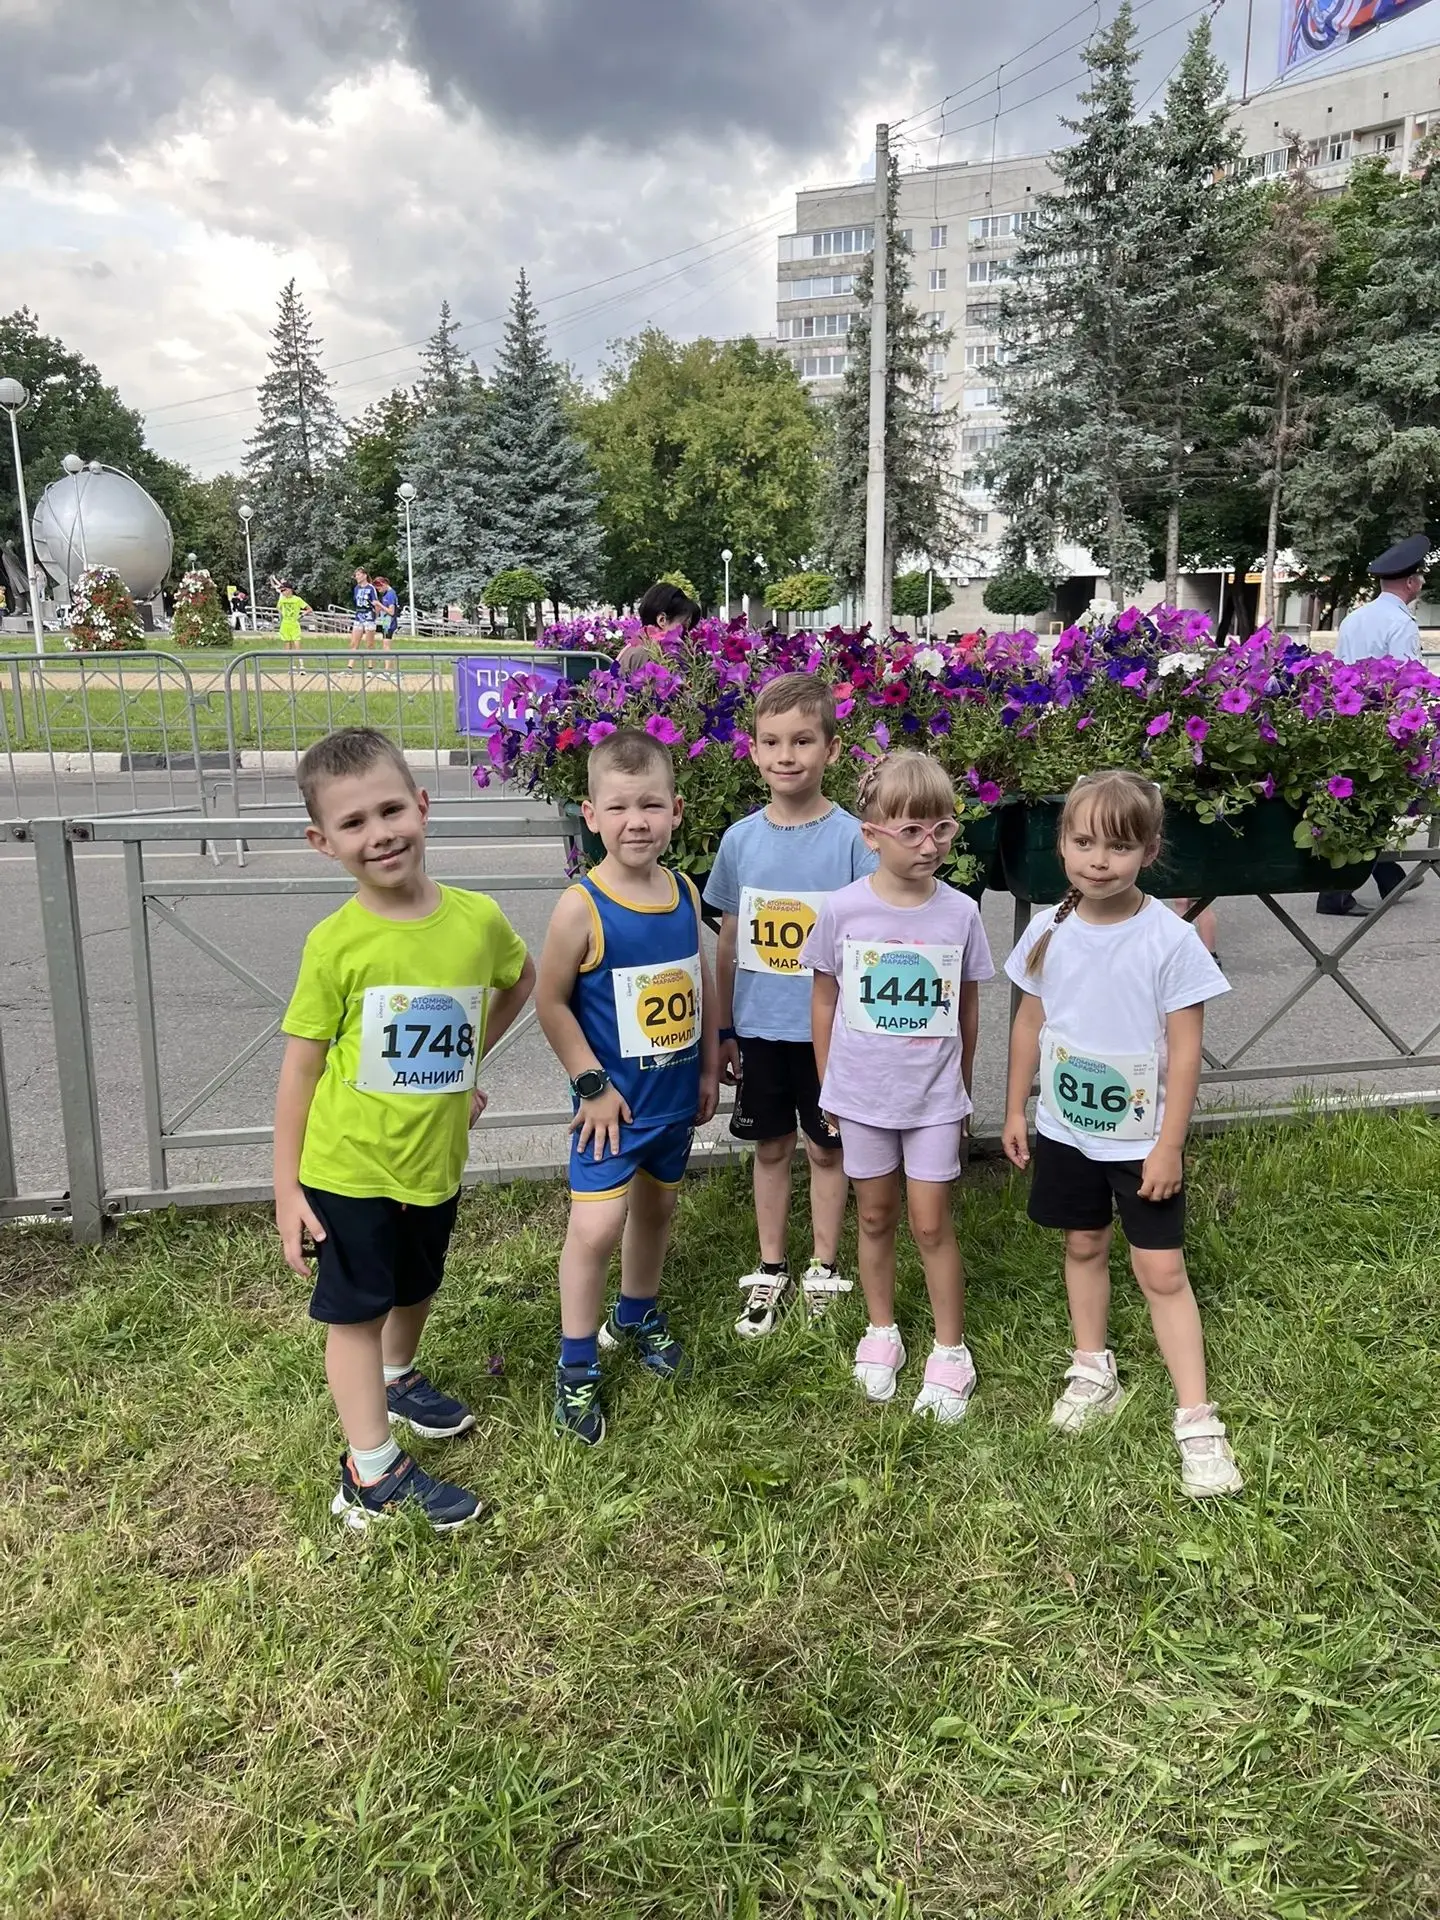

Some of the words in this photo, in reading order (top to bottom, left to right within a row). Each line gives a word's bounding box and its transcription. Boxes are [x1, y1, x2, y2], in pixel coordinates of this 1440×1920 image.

[476, 669, 530, 687] ПР
[750, 919, 816, 949] 110
[652, 975, 684, 986] МАРАФОН
[411, 996, 453, 1004] АТОМНЫЙ
[859, 975, 944, 1007] 1441
[411, 1003, 453, 1011] МАРАФОН
[644, 989, 696, 1027] 201
[876, 1016, 928, 1029] ДАРЬЯ
[381, 1023, 473, 1059] 1748
[651, 1027, 696, 1048] КИРИЛЛ
[1068, 1055, 1107, 1069] АТОМНЫЙ
[1069, 1060, 1107, 1074] МАРАФОН
[393, 1070, 464, 1086] ДАНИИЛ
[1059, 1072, 1127, 1113] 816
[1063, 1109, 1117, 1132] МАРИЯ
